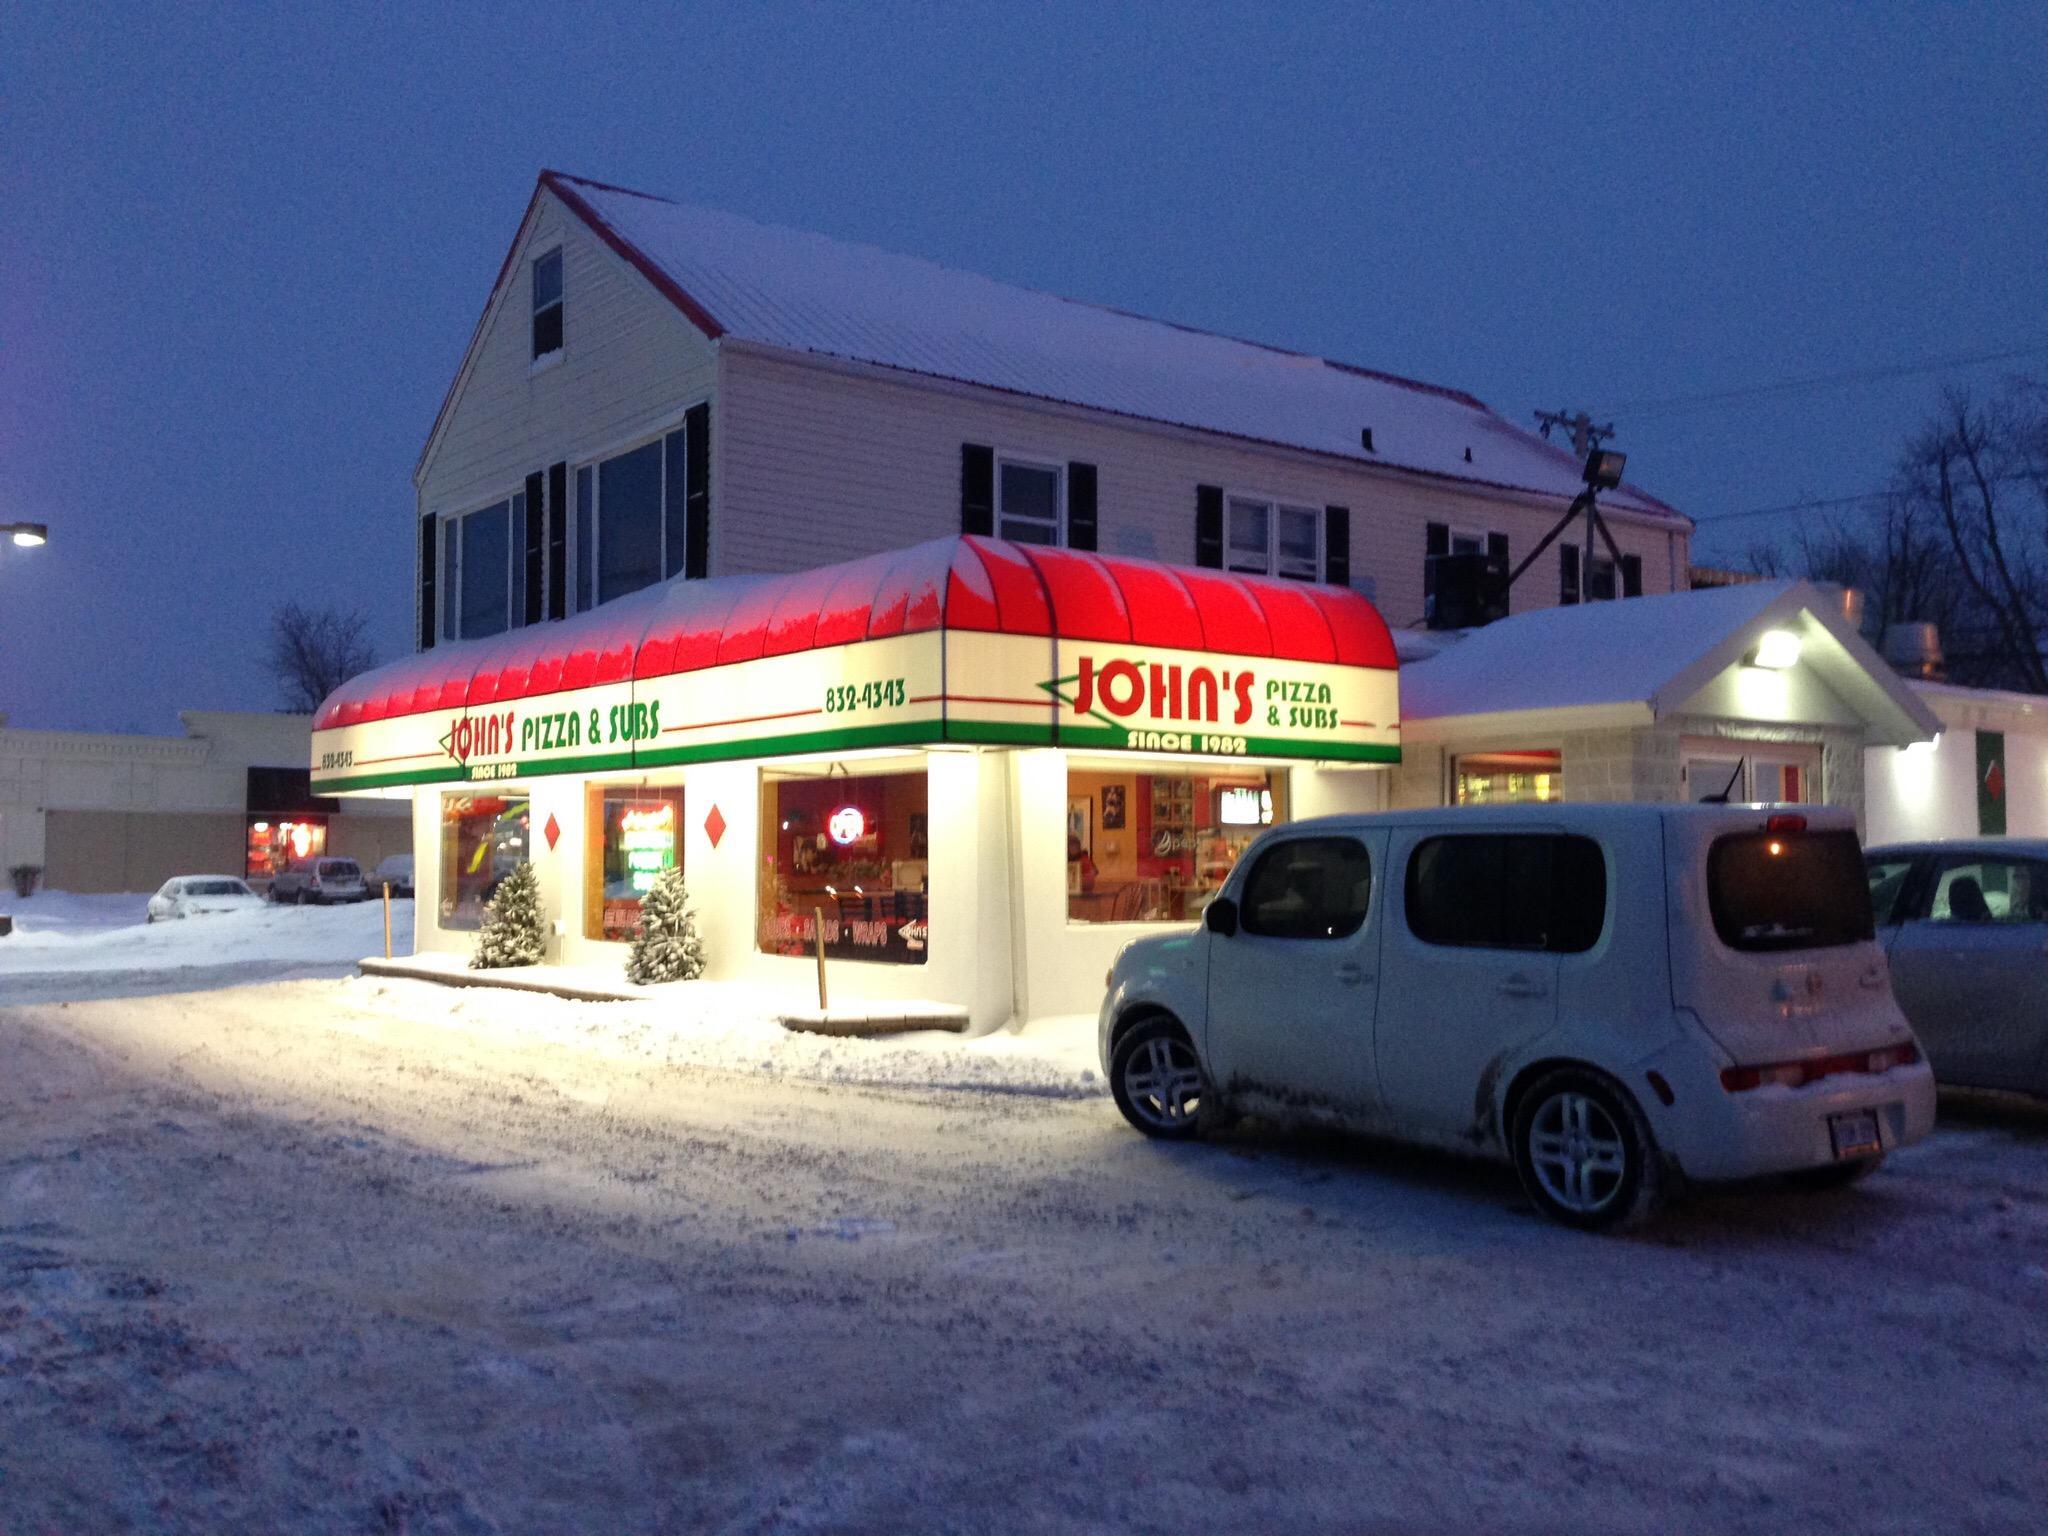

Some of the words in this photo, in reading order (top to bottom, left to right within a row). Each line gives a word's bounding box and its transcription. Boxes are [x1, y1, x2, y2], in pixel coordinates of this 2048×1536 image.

[826, 678, 905, 713] 832-4343
[1074, 656, 1254, 724] JOHN'S
[1266, 680, 1331, 704] PIZZA
[1267, 705, 1280, 726] &
[1289, 706, 1338, 729] SUBS
[449, 712, 514, 760] JOHN'S
[522, 710, 580, 751] PIZZA
[588, 708, 601, 744] &
[609, 700, 659, 743] SUBS
[1127, 731, 1192, 752] SINCE
[1201, 735, 1248, 755] 1982
[322, 750, 353, 770] 832-4343
[471, 765, 496, 780] SINCE
